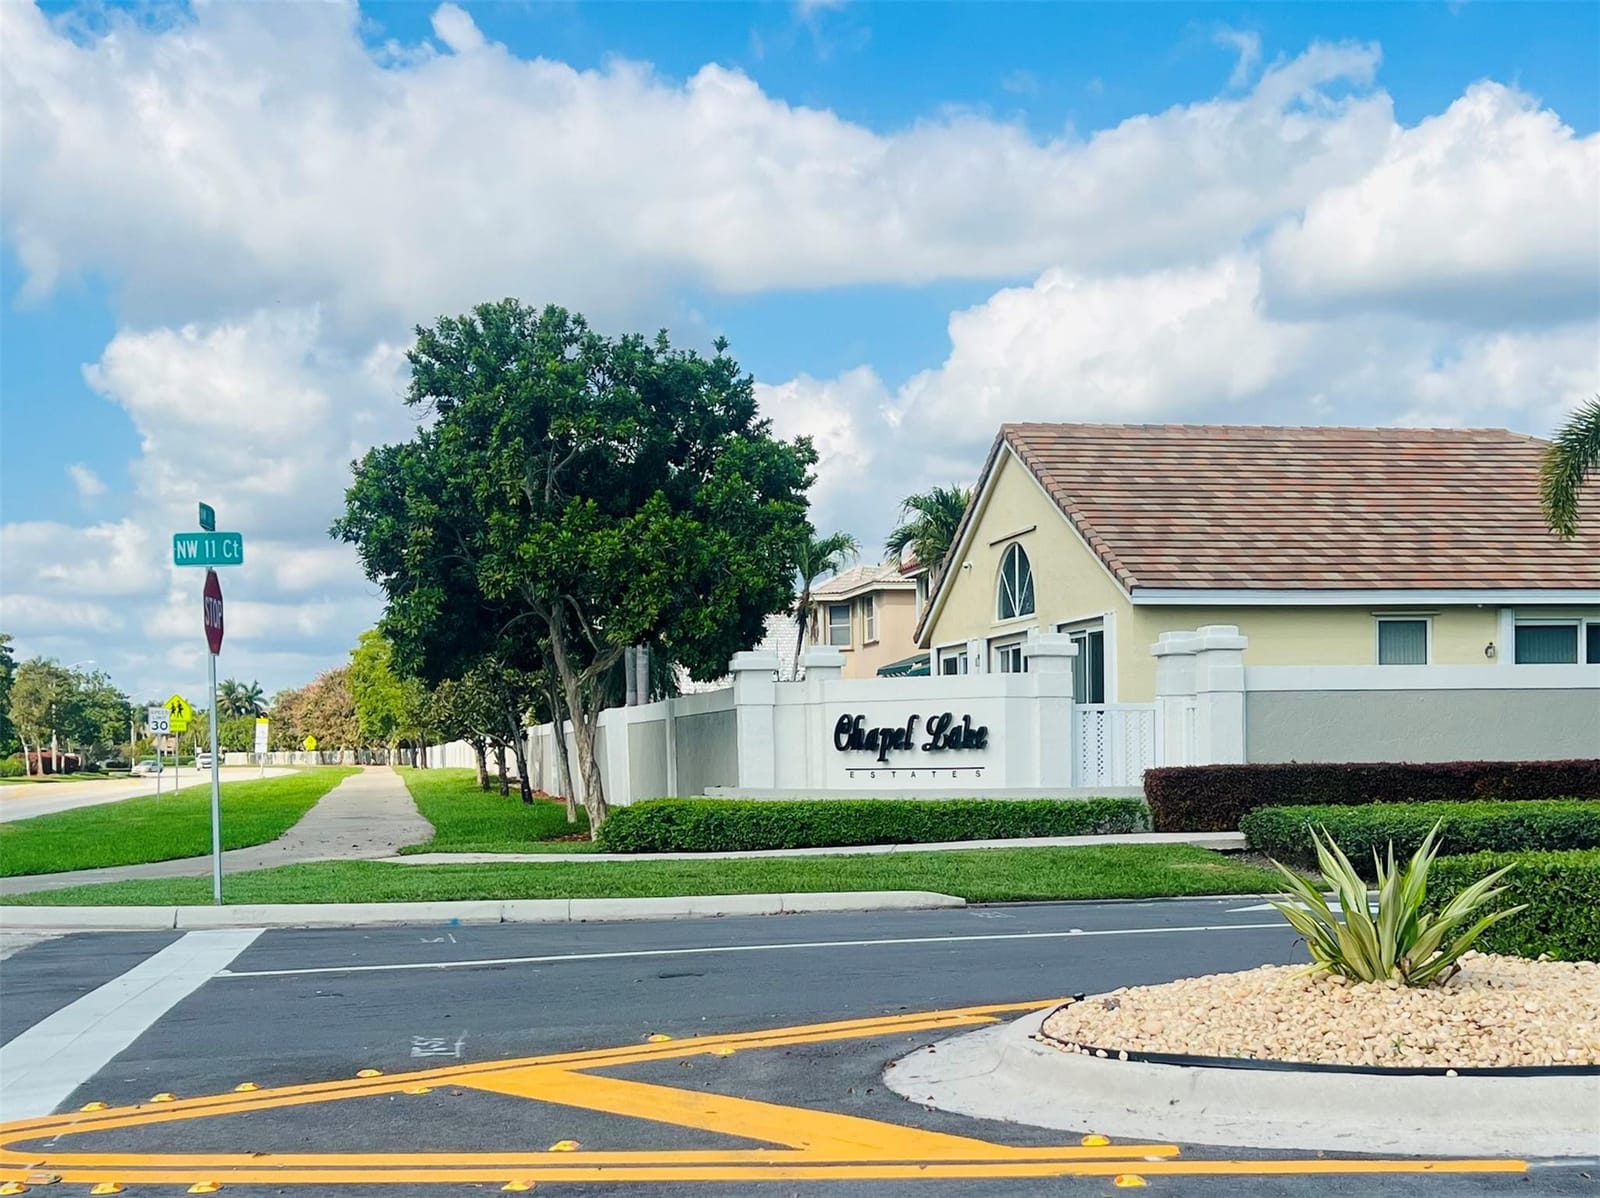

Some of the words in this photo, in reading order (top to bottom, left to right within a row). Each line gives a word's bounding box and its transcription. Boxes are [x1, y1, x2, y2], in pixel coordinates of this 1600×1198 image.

[176, 540, 198, 559] NW
[204, 540, 216, 558] 11
[222, 540, 239, 558] Ct
[204, 596, 222, 629] STOP
[151, 721, 168, 730] 30
[834, 713, 920, 762] Chapel
[921, 712, 988, 752] Lake
[849, 770, 981, 779] ESTATES
